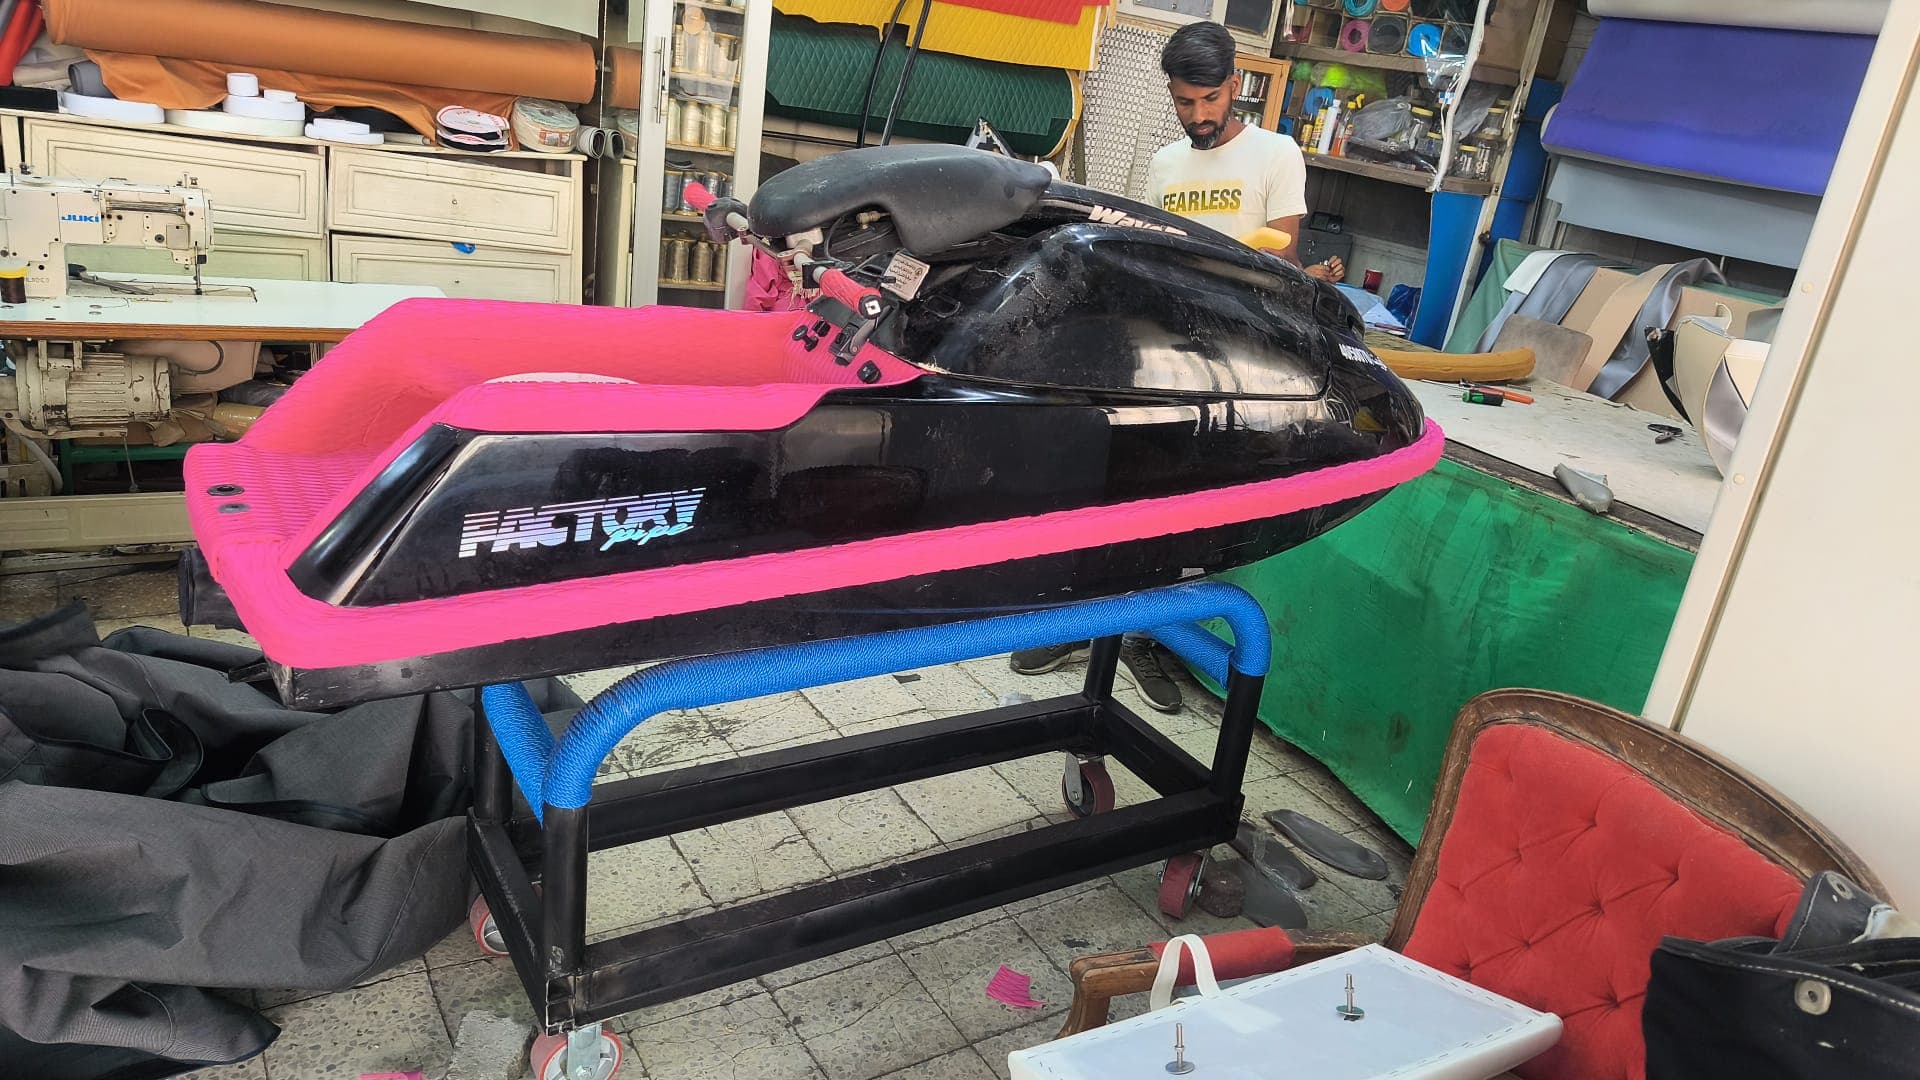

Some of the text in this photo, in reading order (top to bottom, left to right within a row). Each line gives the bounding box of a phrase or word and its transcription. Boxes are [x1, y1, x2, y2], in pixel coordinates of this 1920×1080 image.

[1163, 188, 1242, 212] FEARLESS
[60, 214, 99, 222] JUKI
[459, 487, 707, 558] FACTORY
[600, 522, 694, 551] pipe
